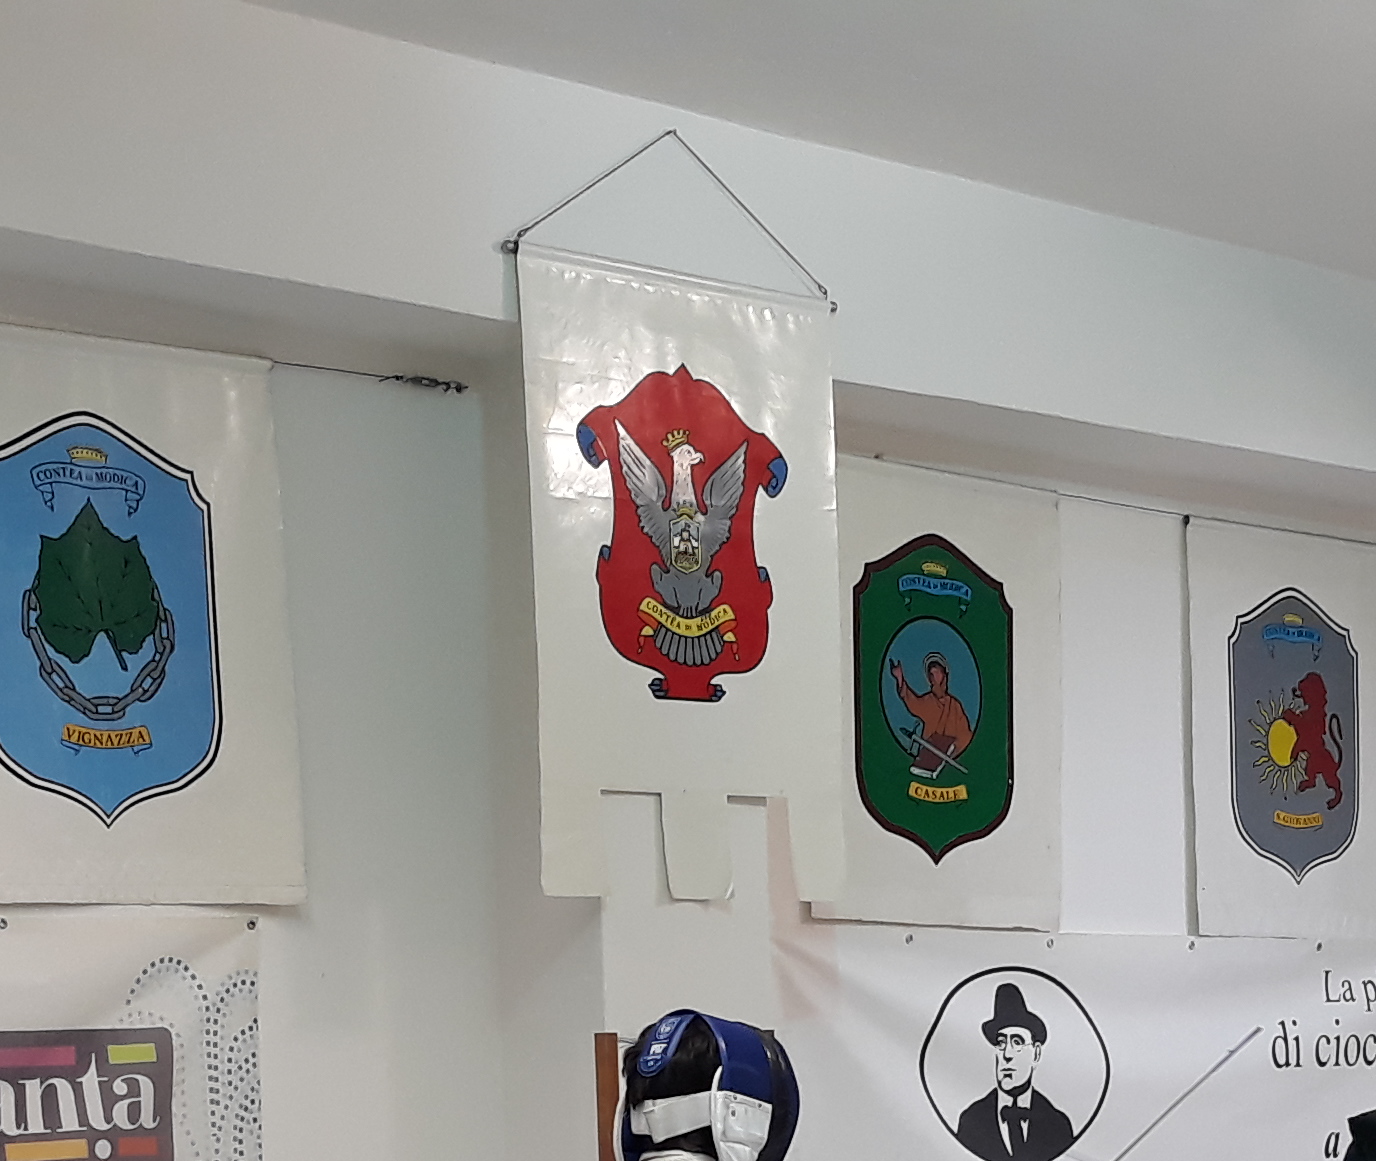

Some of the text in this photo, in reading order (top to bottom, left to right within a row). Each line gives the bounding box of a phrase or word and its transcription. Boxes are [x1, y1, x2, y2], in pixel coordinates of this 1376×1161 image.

[36, 466, 83, 483] CONTEA
[94, 471, 139, 491] MODICA
[66, 726, 147, 747] VIGNAZZA
[1323, 970, 1355, 1003] La
[1271, 1021, 1303, 1069] di
